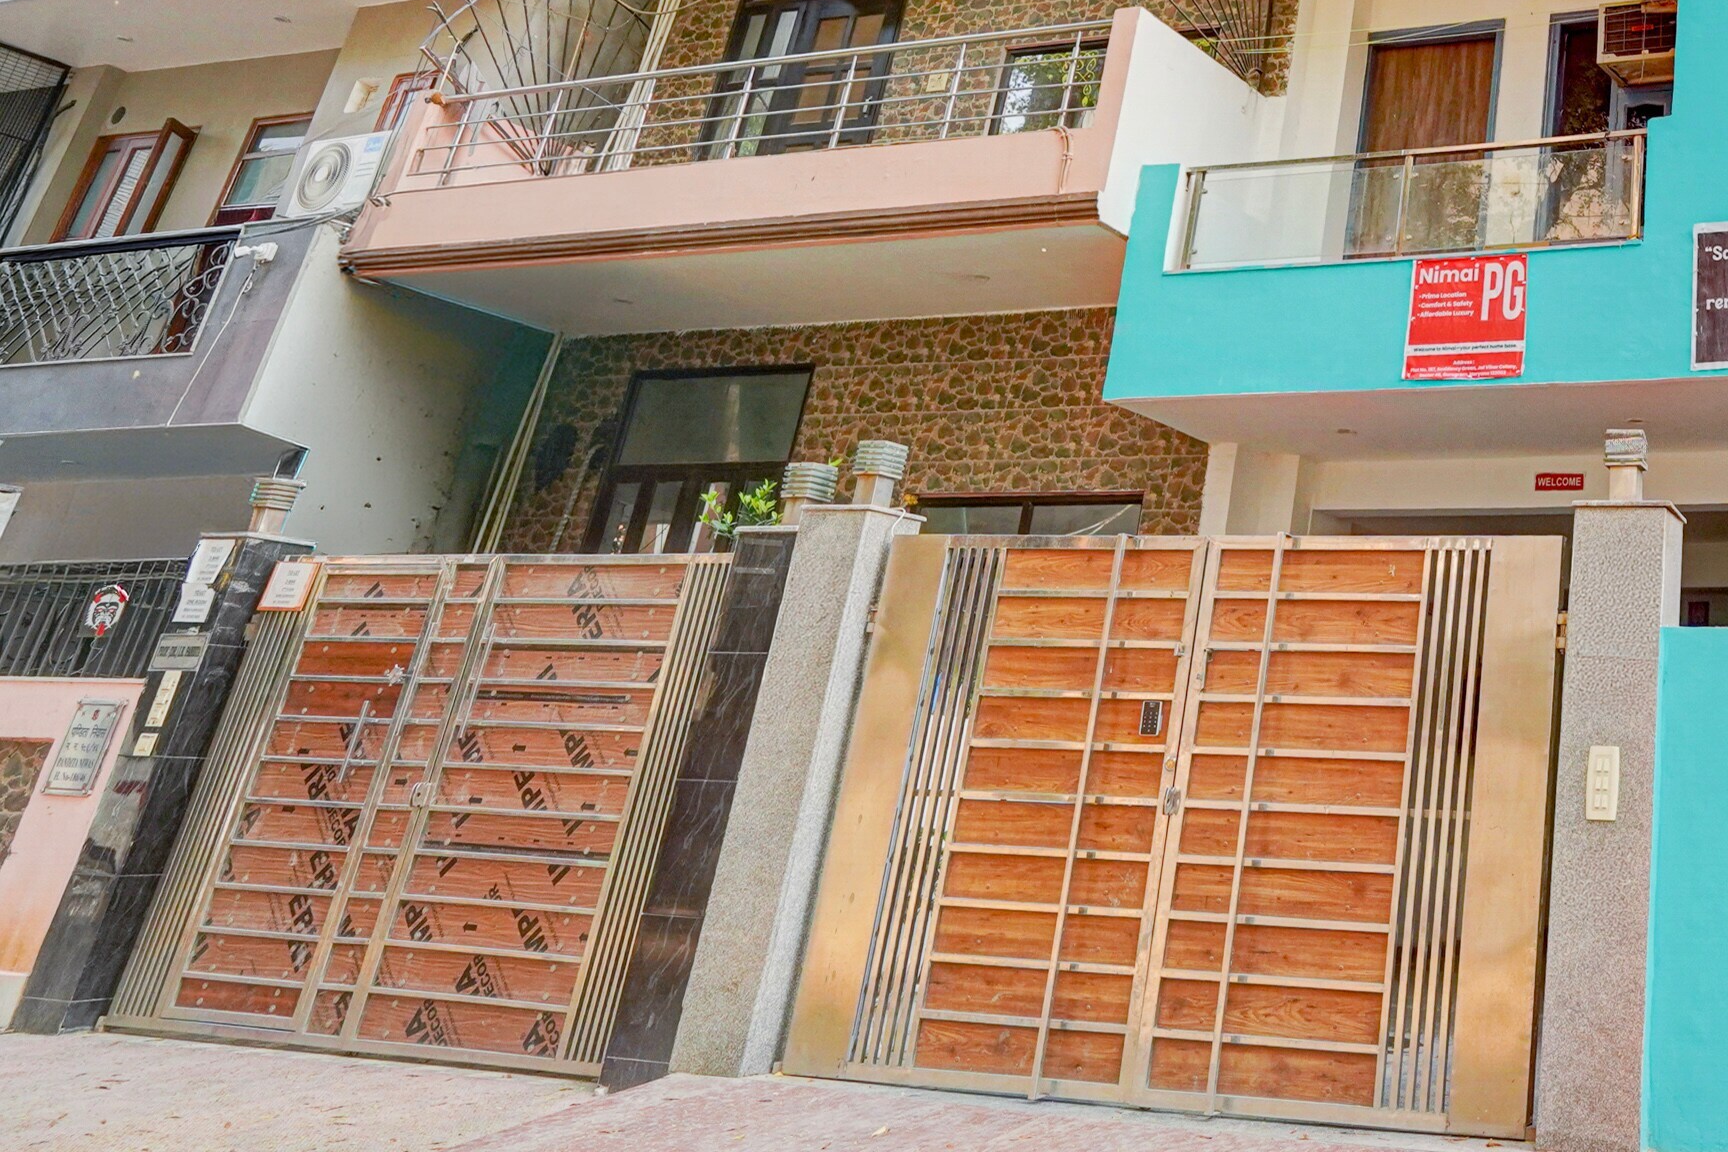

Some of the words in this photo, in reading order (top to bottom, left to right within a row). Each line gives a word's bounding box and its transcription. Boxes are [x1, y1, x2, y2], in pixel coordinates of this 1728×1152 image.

[1419, 263, 1480, 284] Nimai
[1480, 260, 1525, 321] PG
[1440, 291, 1467, 299] Location
[1453, 300, 1473, 309] Safety
[1537, 477, 1582, 487] WELCOME
